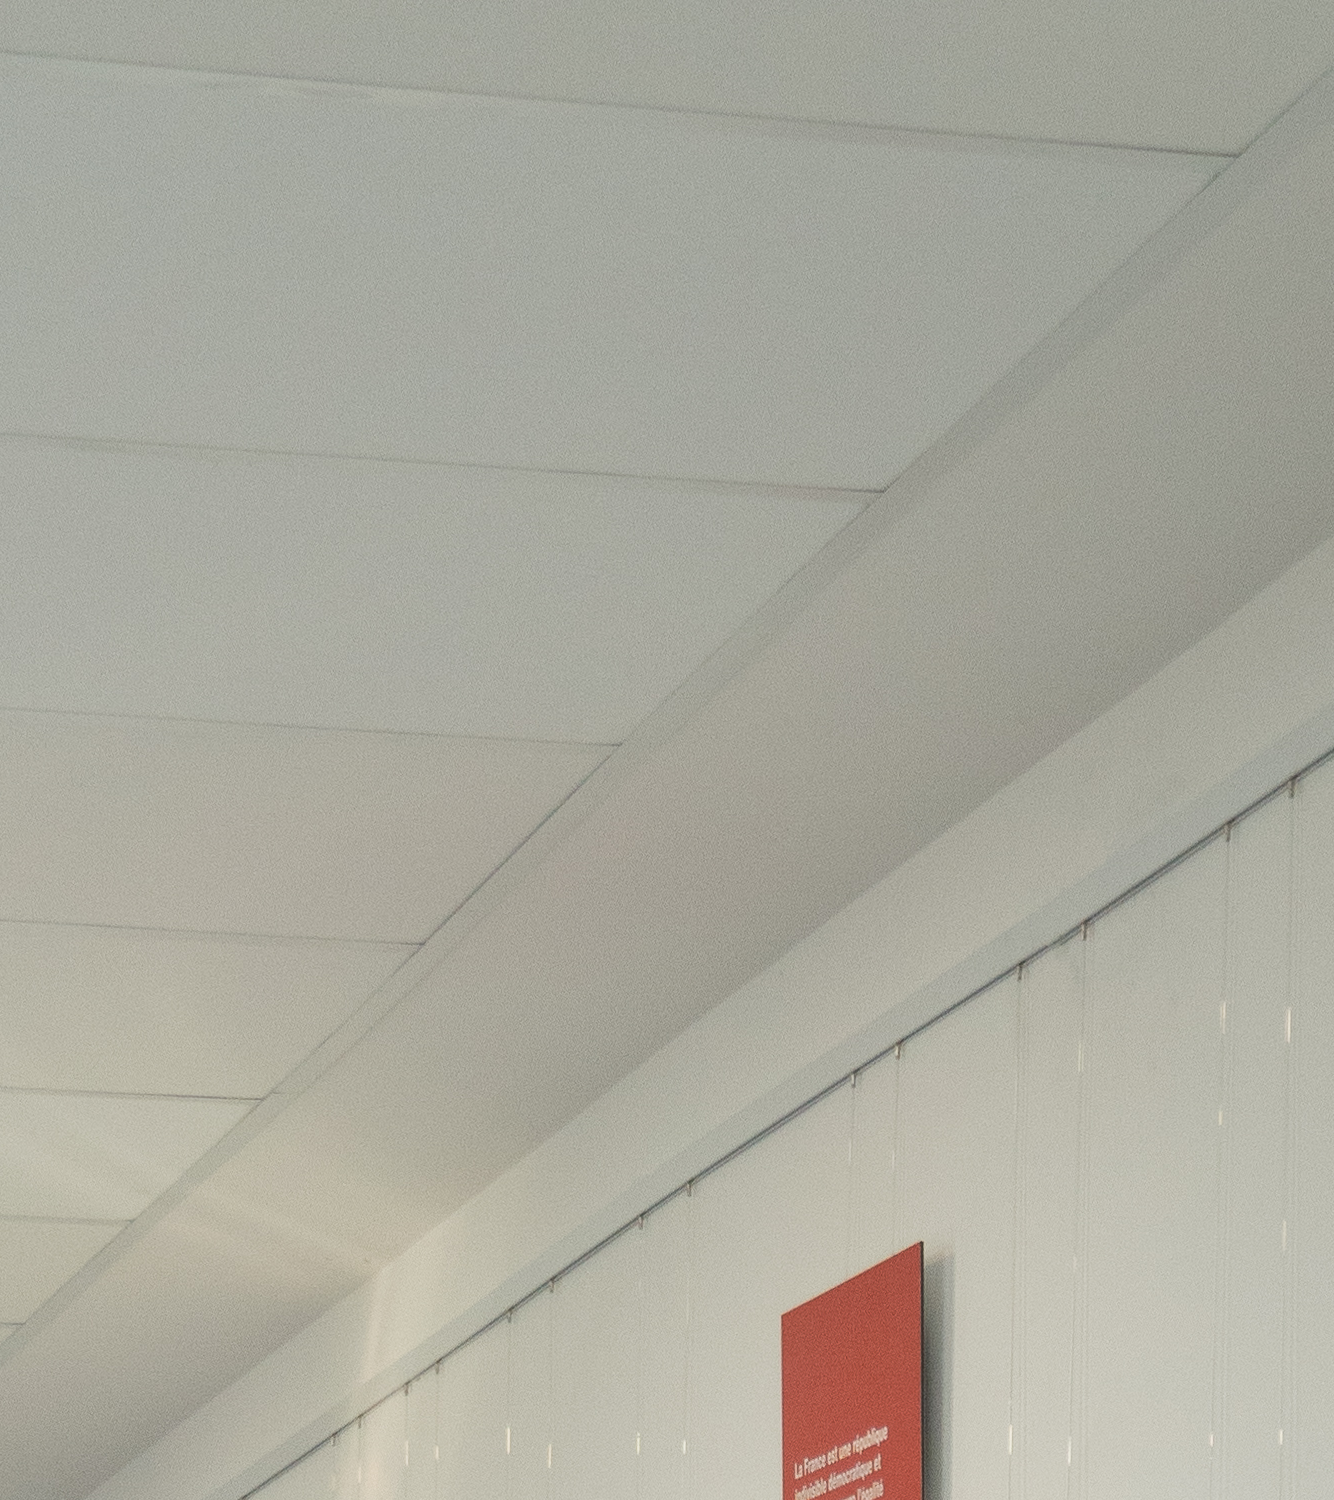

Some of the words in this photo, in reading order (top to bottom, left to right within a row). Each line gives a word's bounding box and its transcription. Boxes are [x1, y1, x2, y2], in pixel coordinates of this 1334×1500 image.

[804, 1453, 827, 1475] France
[827, 1445, 839, 1465] est
[839, 1442, 852, 1459] une
[852, 1425, 888, 1454] république
[827, 1460, 873, 1491] démocratique
